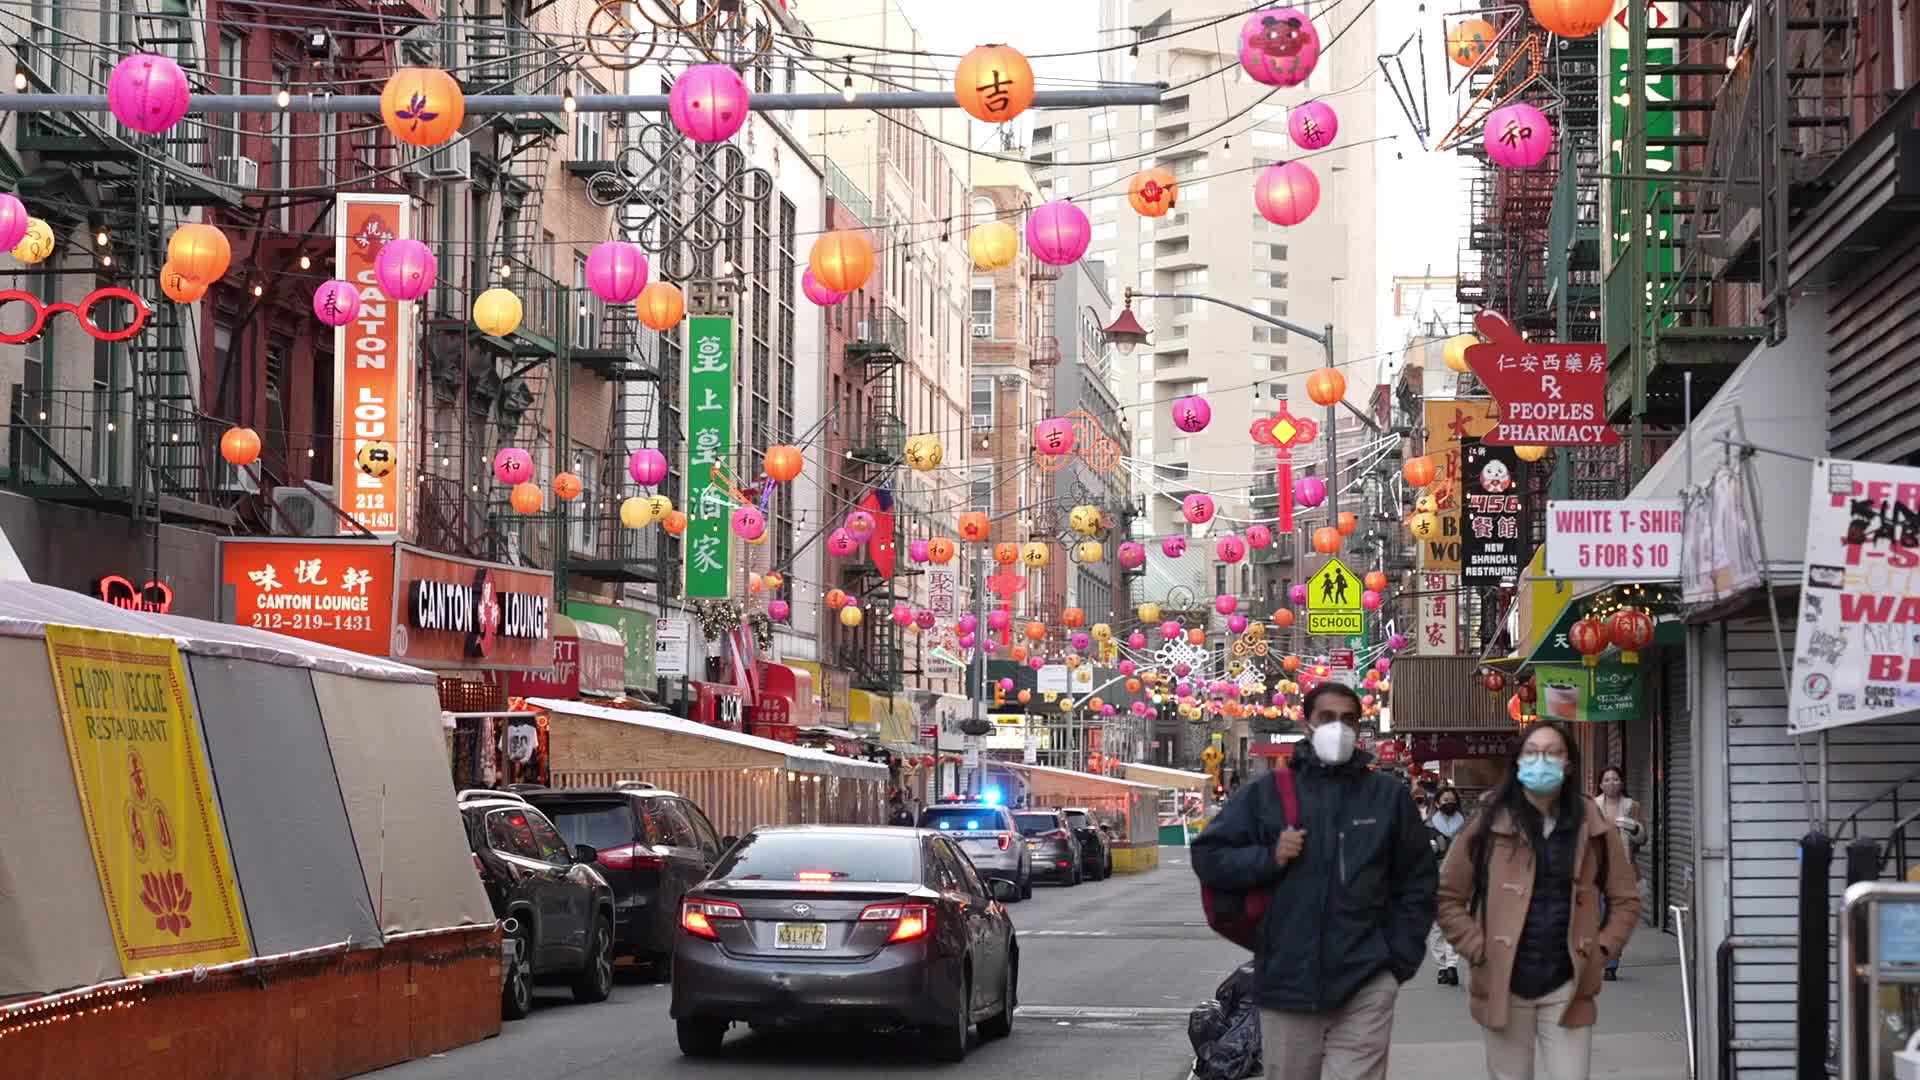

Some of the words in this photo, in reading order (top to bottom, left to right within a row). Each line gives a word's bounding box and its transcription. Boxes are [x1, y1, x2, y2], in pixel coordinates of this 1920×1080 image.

[975, 70, 1014, 113] 吉
[1499, 119, 1533, 149] 和
[323, 289, 343, 322] 春
[355, 269, 387, 369] CANTON
[1497, 353, 1606, 374] 仁安西藥房
[1509, 402, 1595, 421] PEOPLES
[354, 387, 387, 489] LOUE
[1045, 428, 1063, 449] 吉
[1498, 423, 1606, 442] PHARMACY
[501, 457, 520, 474] 和
[355, 493, 385, 509] 212
[650, 500, 662, 515] 吉
[1468, 494, 1519, 513] 456
[1471, 515, 1519, 539] 餐館
[1556, 510, 1612, 534] WHITE
[1484, 542, 1504, 553] NEW
[1579, 543, 1591, 568] 5
[1595, 543, 1628, 568] FOR
[257, 593, 312, 611] CANTON
[314, 595, 369, 612] LOUNGE
[418, 579, 473, 633] CANTON
[505, 591, 548, 641] LOUNGE
[252, 612, 373, 631] 212-219-1431
[1311, 618, 1359, 628] SCHOOL
[69, 666, 117, 710] HAPPY
[119, 671, 168, 713] VEGGIE
[86, 715, 168, 742] RESTAURANT
